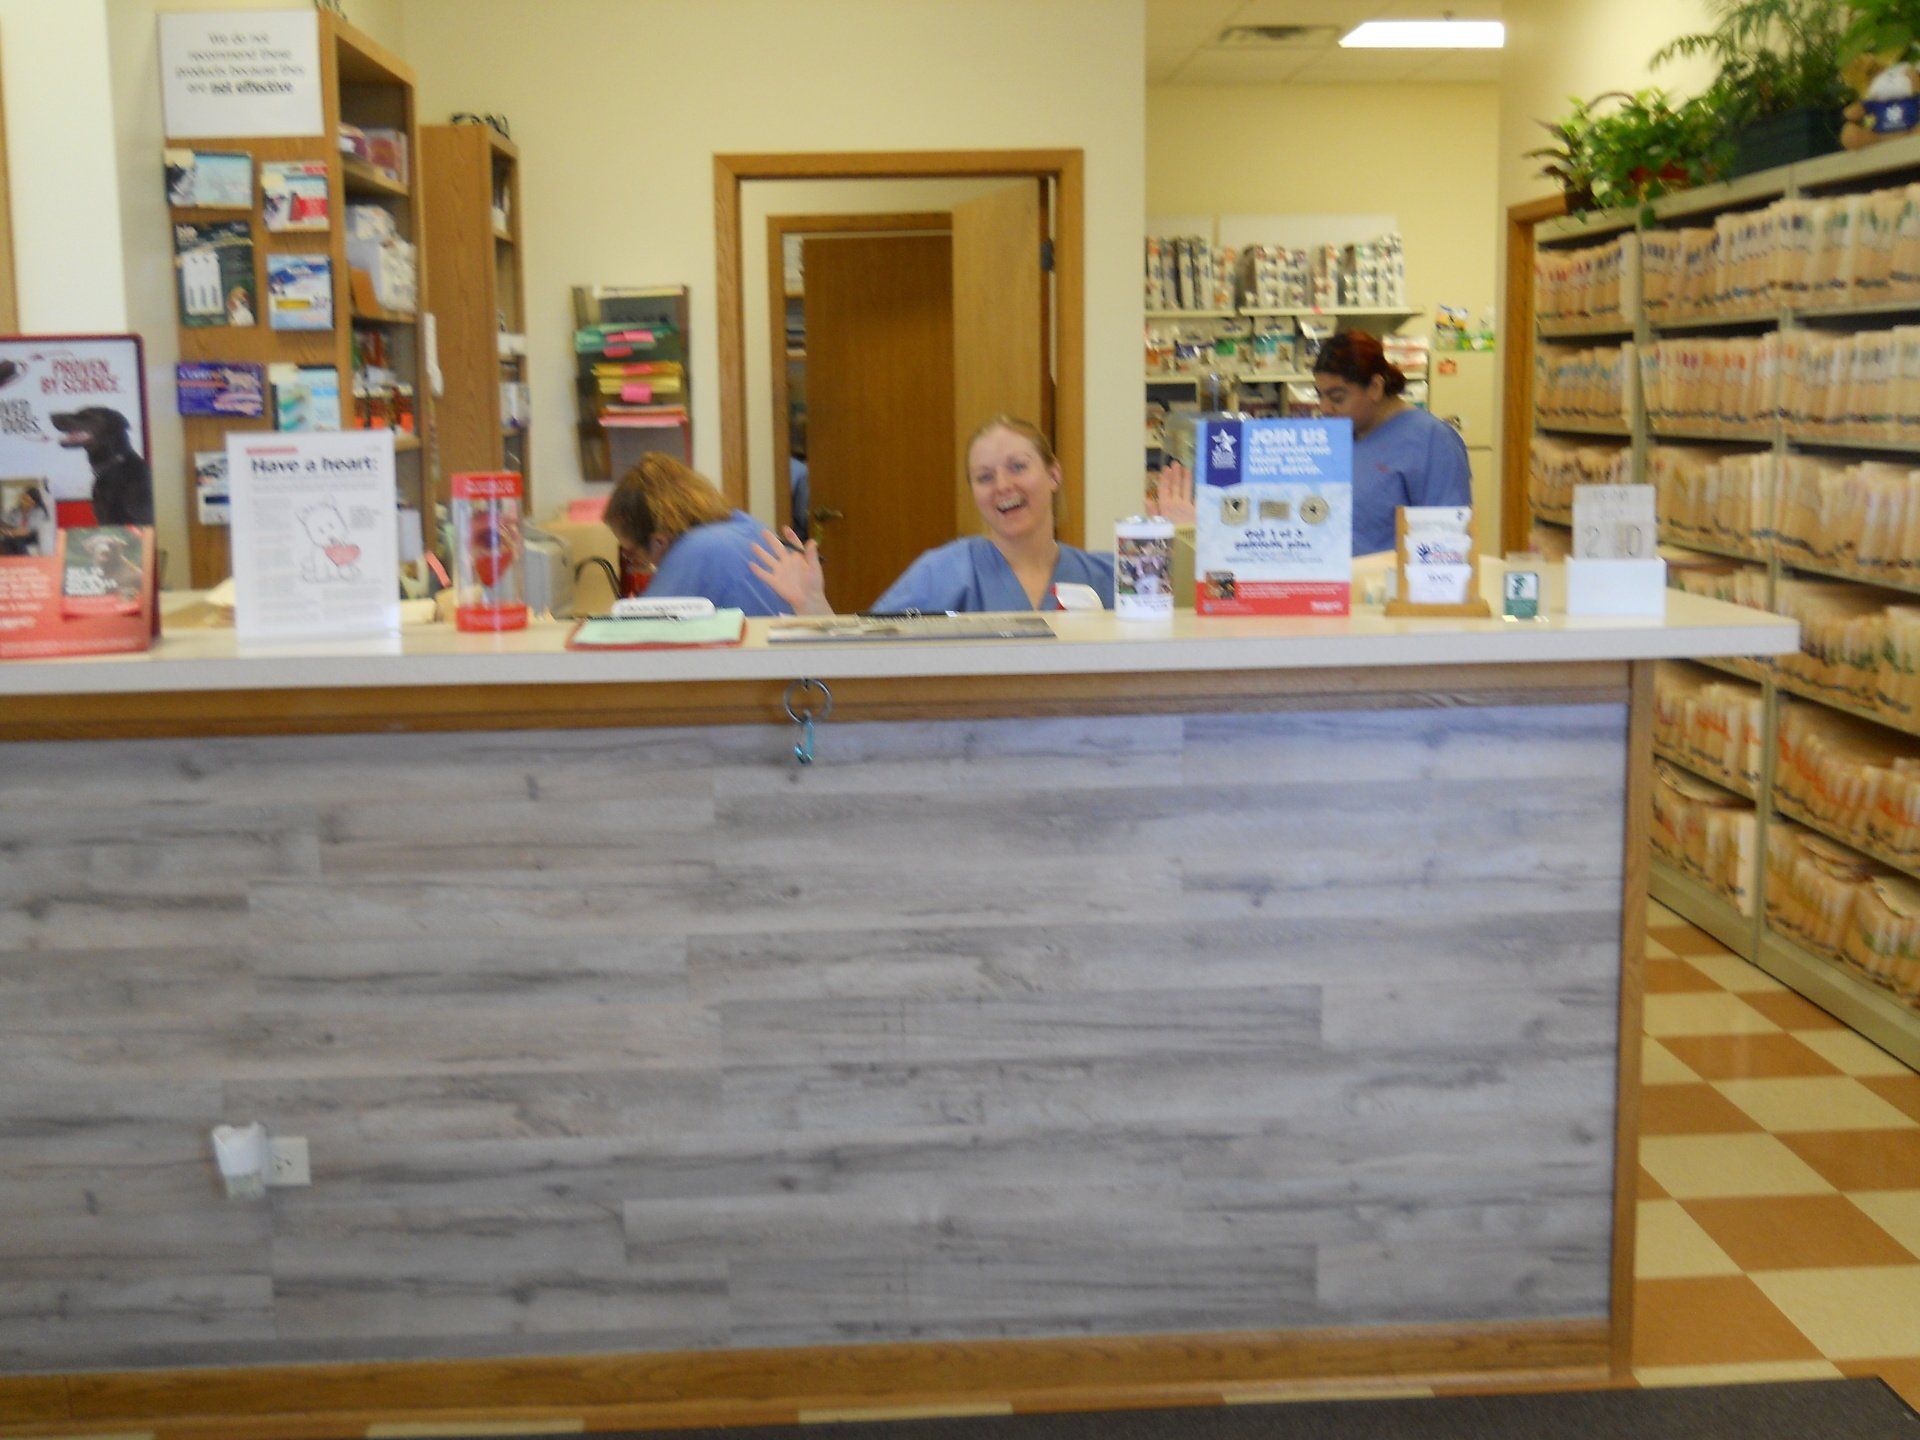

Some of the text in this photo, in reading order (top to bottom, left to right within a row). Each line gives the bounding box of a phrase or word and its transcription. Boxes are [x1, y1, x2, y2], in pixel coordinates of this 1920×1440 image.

[209, 80, 232, 95] not
[235, 78, 293, 95] effective
[52, 359, 111, 376] PROVEN
[62, 376, 119, 394] SCIENCE
[1249, 427, 1329, 446] JOIN US
[250, 456, 299, 473] Have
[305, 460, 317, 471] a
